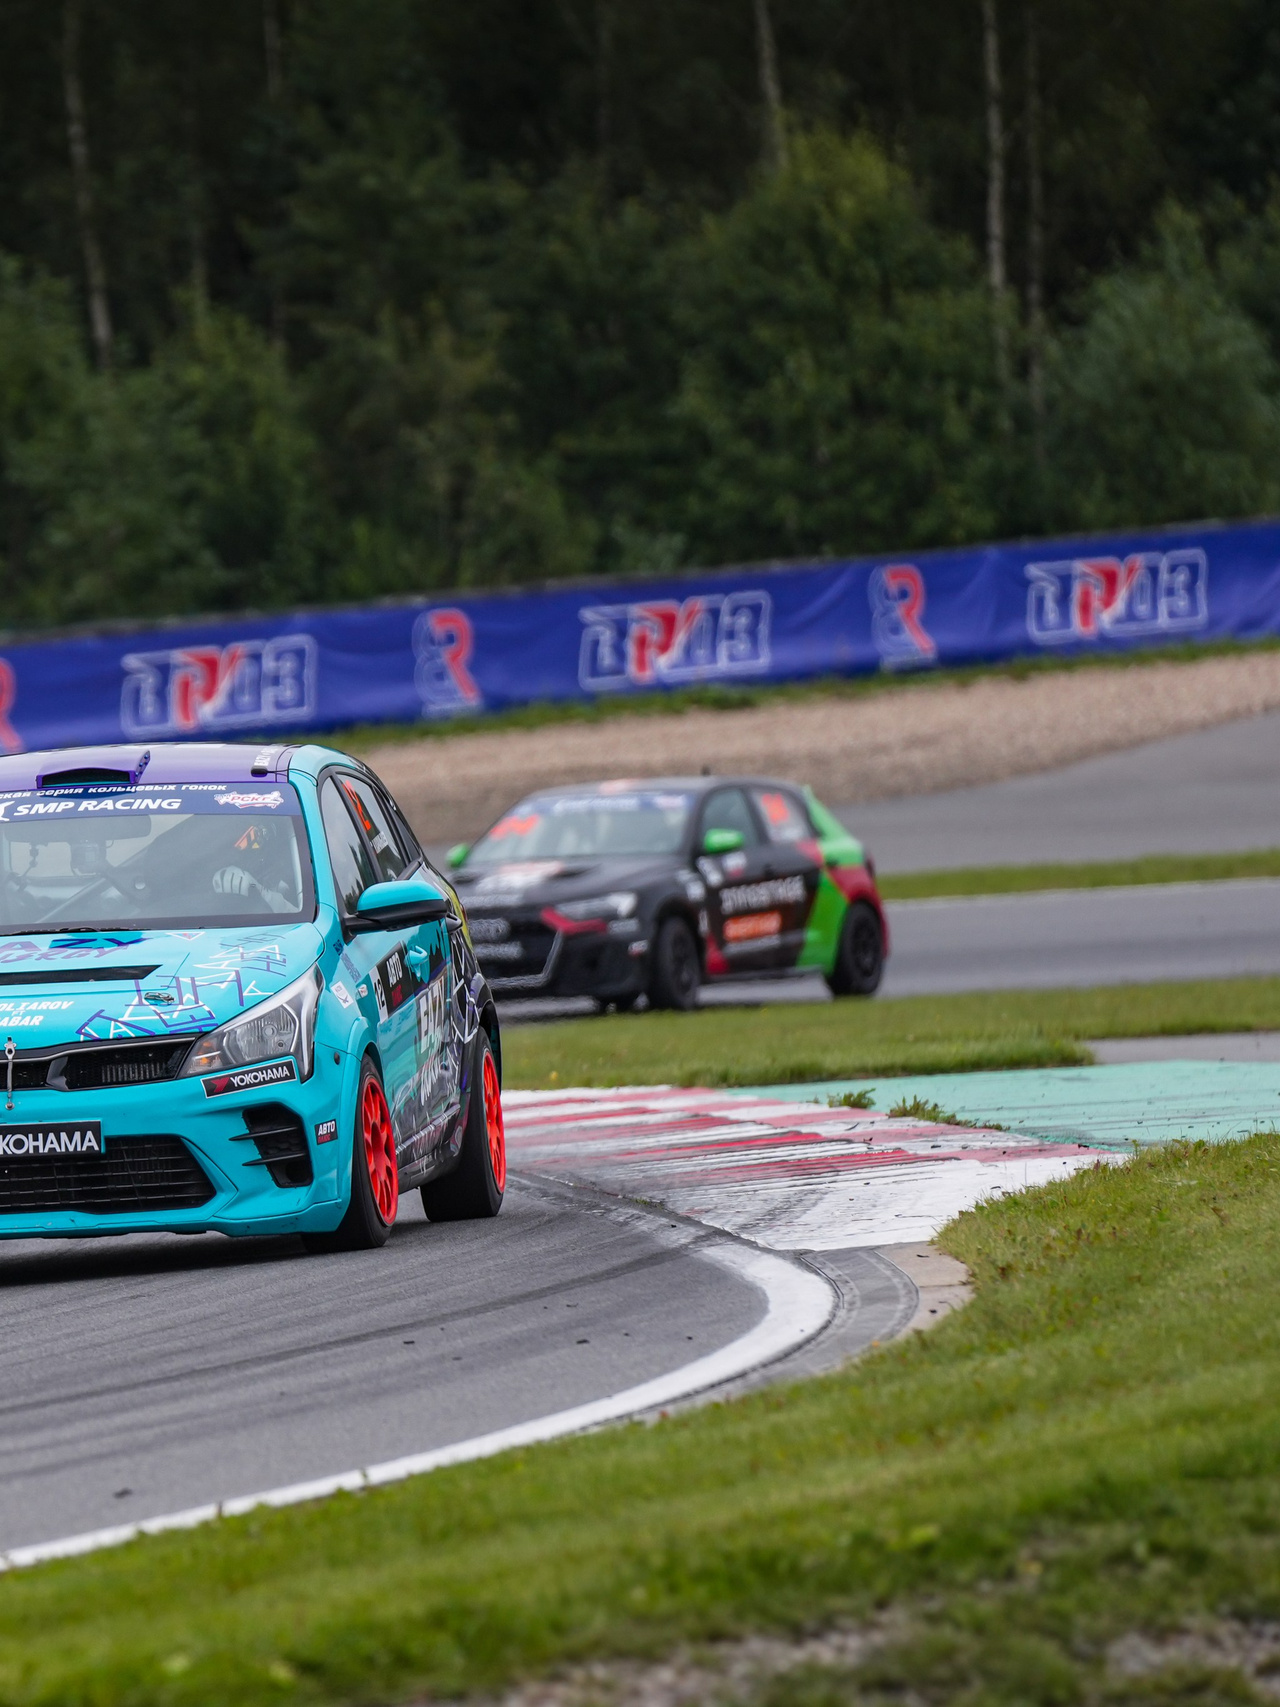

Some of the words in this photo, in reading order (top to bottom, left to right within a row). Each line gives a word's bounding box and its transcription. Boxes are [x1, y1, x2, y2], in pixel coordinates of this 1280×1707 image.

[36, 788, 84, 797] серия
[13, 801, 75, 816] SMP
[77, 799, 182, 811] RACING
[230, 1065, 290, 1088] YOKOHAMA
[317, 1119, 336, 1136] АВТО
